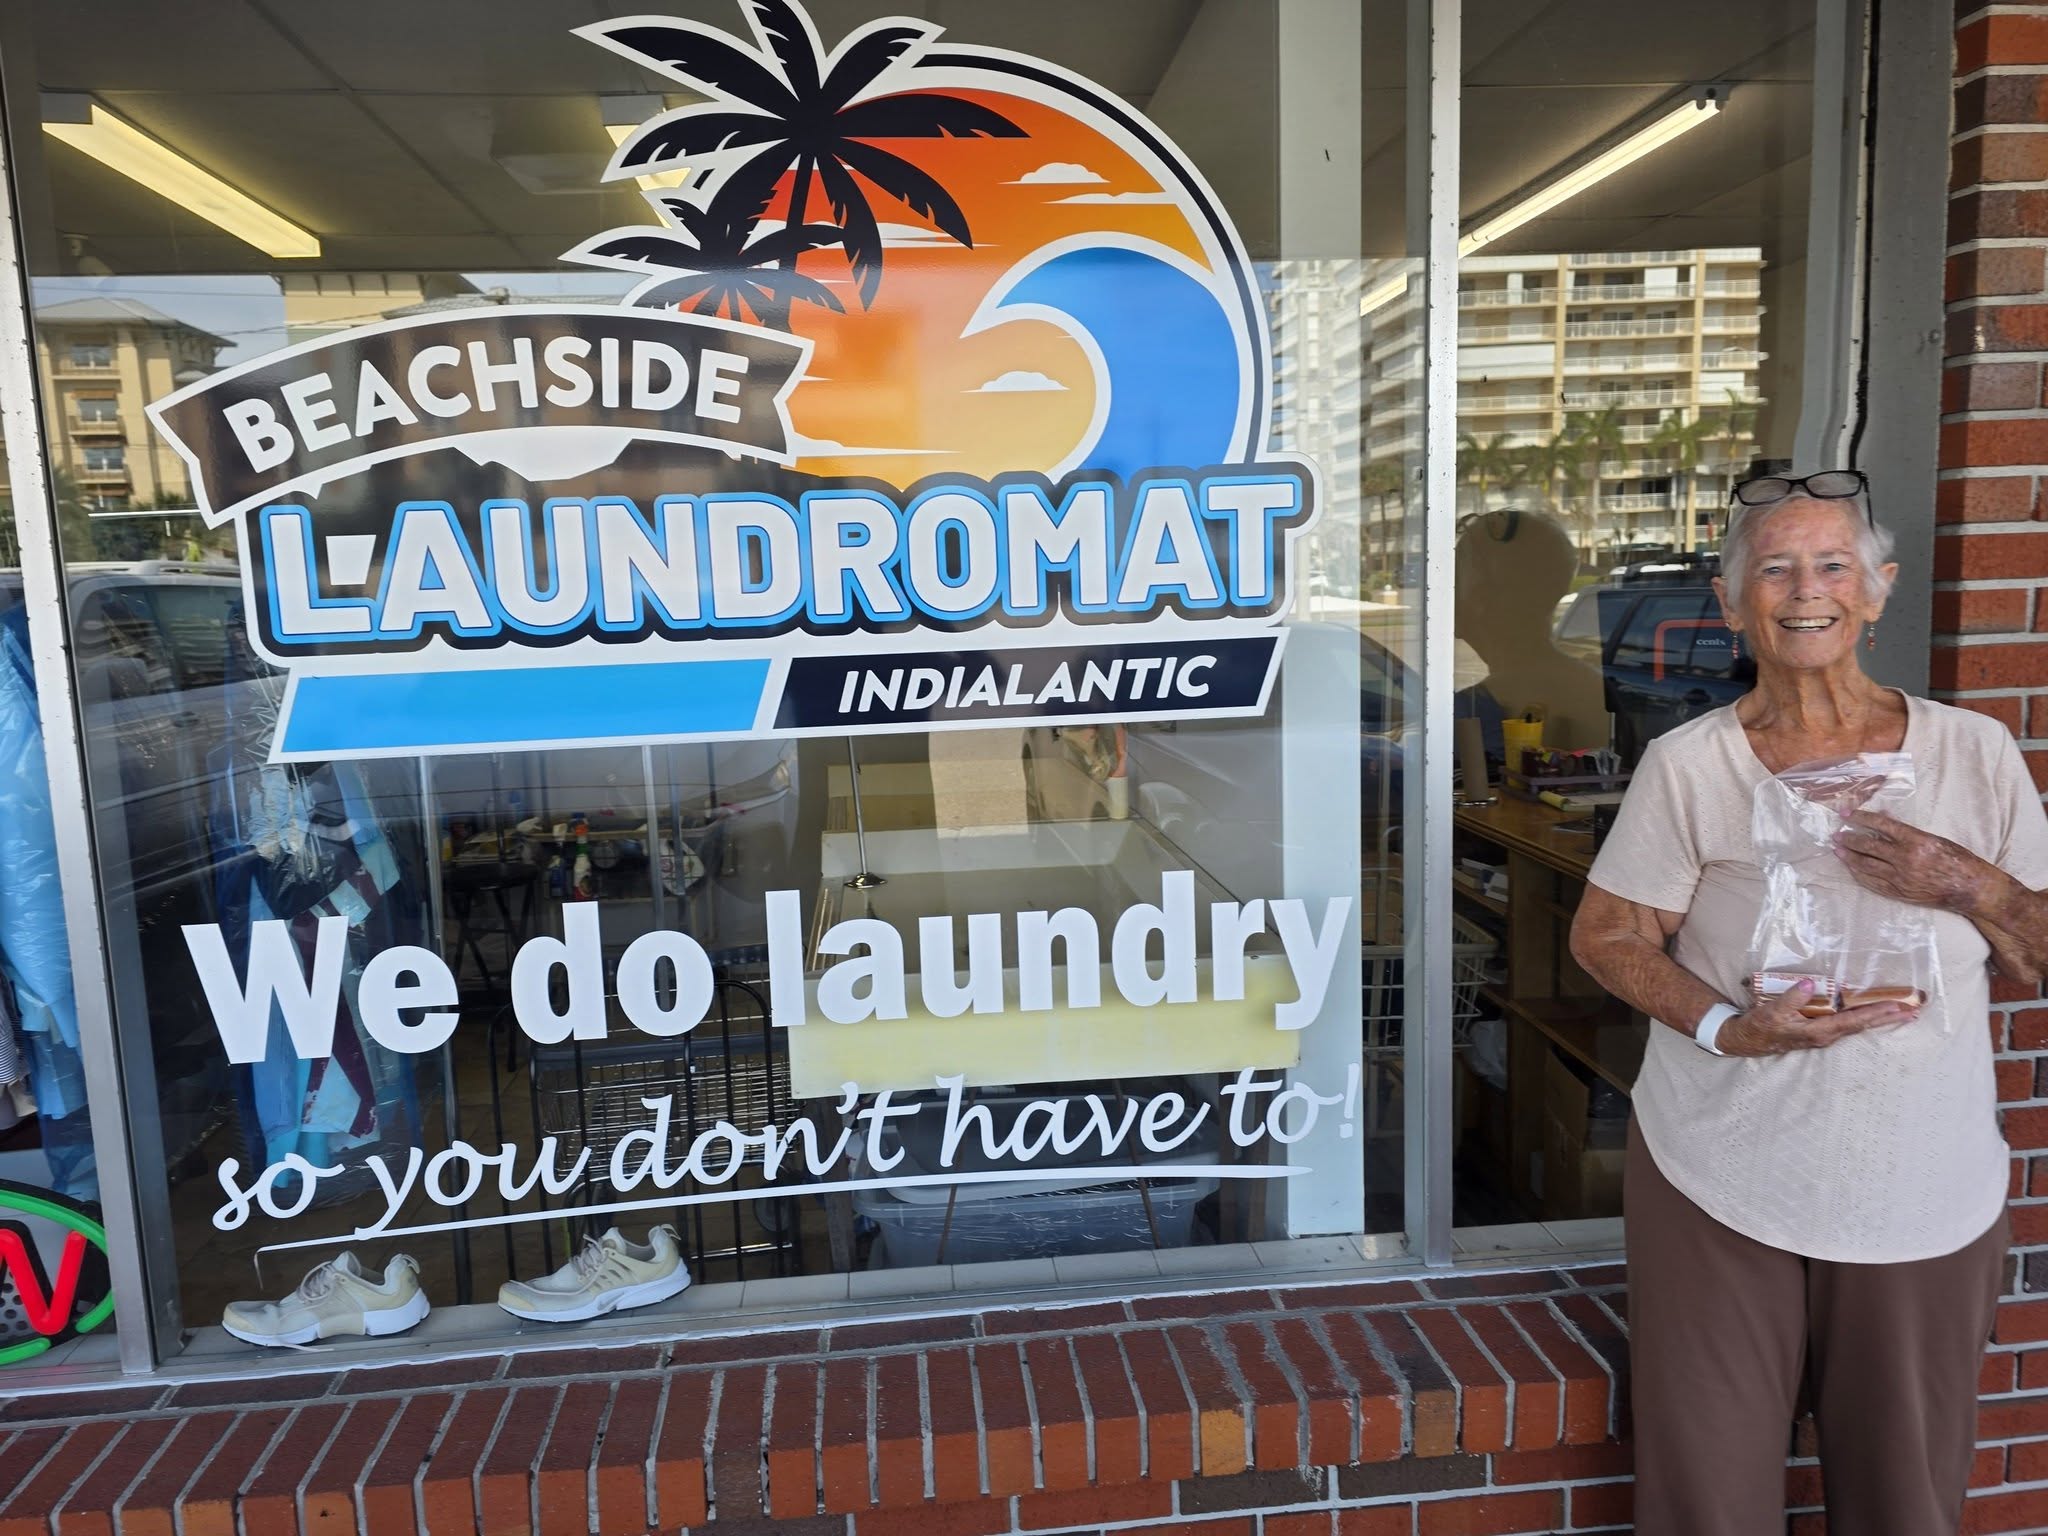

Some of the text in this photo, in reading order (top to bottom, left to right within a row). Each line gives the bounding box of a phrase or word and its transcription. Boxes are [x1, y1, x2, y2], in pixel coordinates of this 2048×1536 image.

[223, 336, 750, 474] BEACHSIDE
[259, 474, 1303, 644] LAUNDROMAT
[838, 654, 1218, 714] INDIALANTIC
[181, 870, 1353, 1065] We do laundry
[211, 1152, 345, 1232] so
[354, 1137, 590, 1241] you
[934, 1073, 1210, 1168] have
[1221, 1063, 1362, 1147] to!
